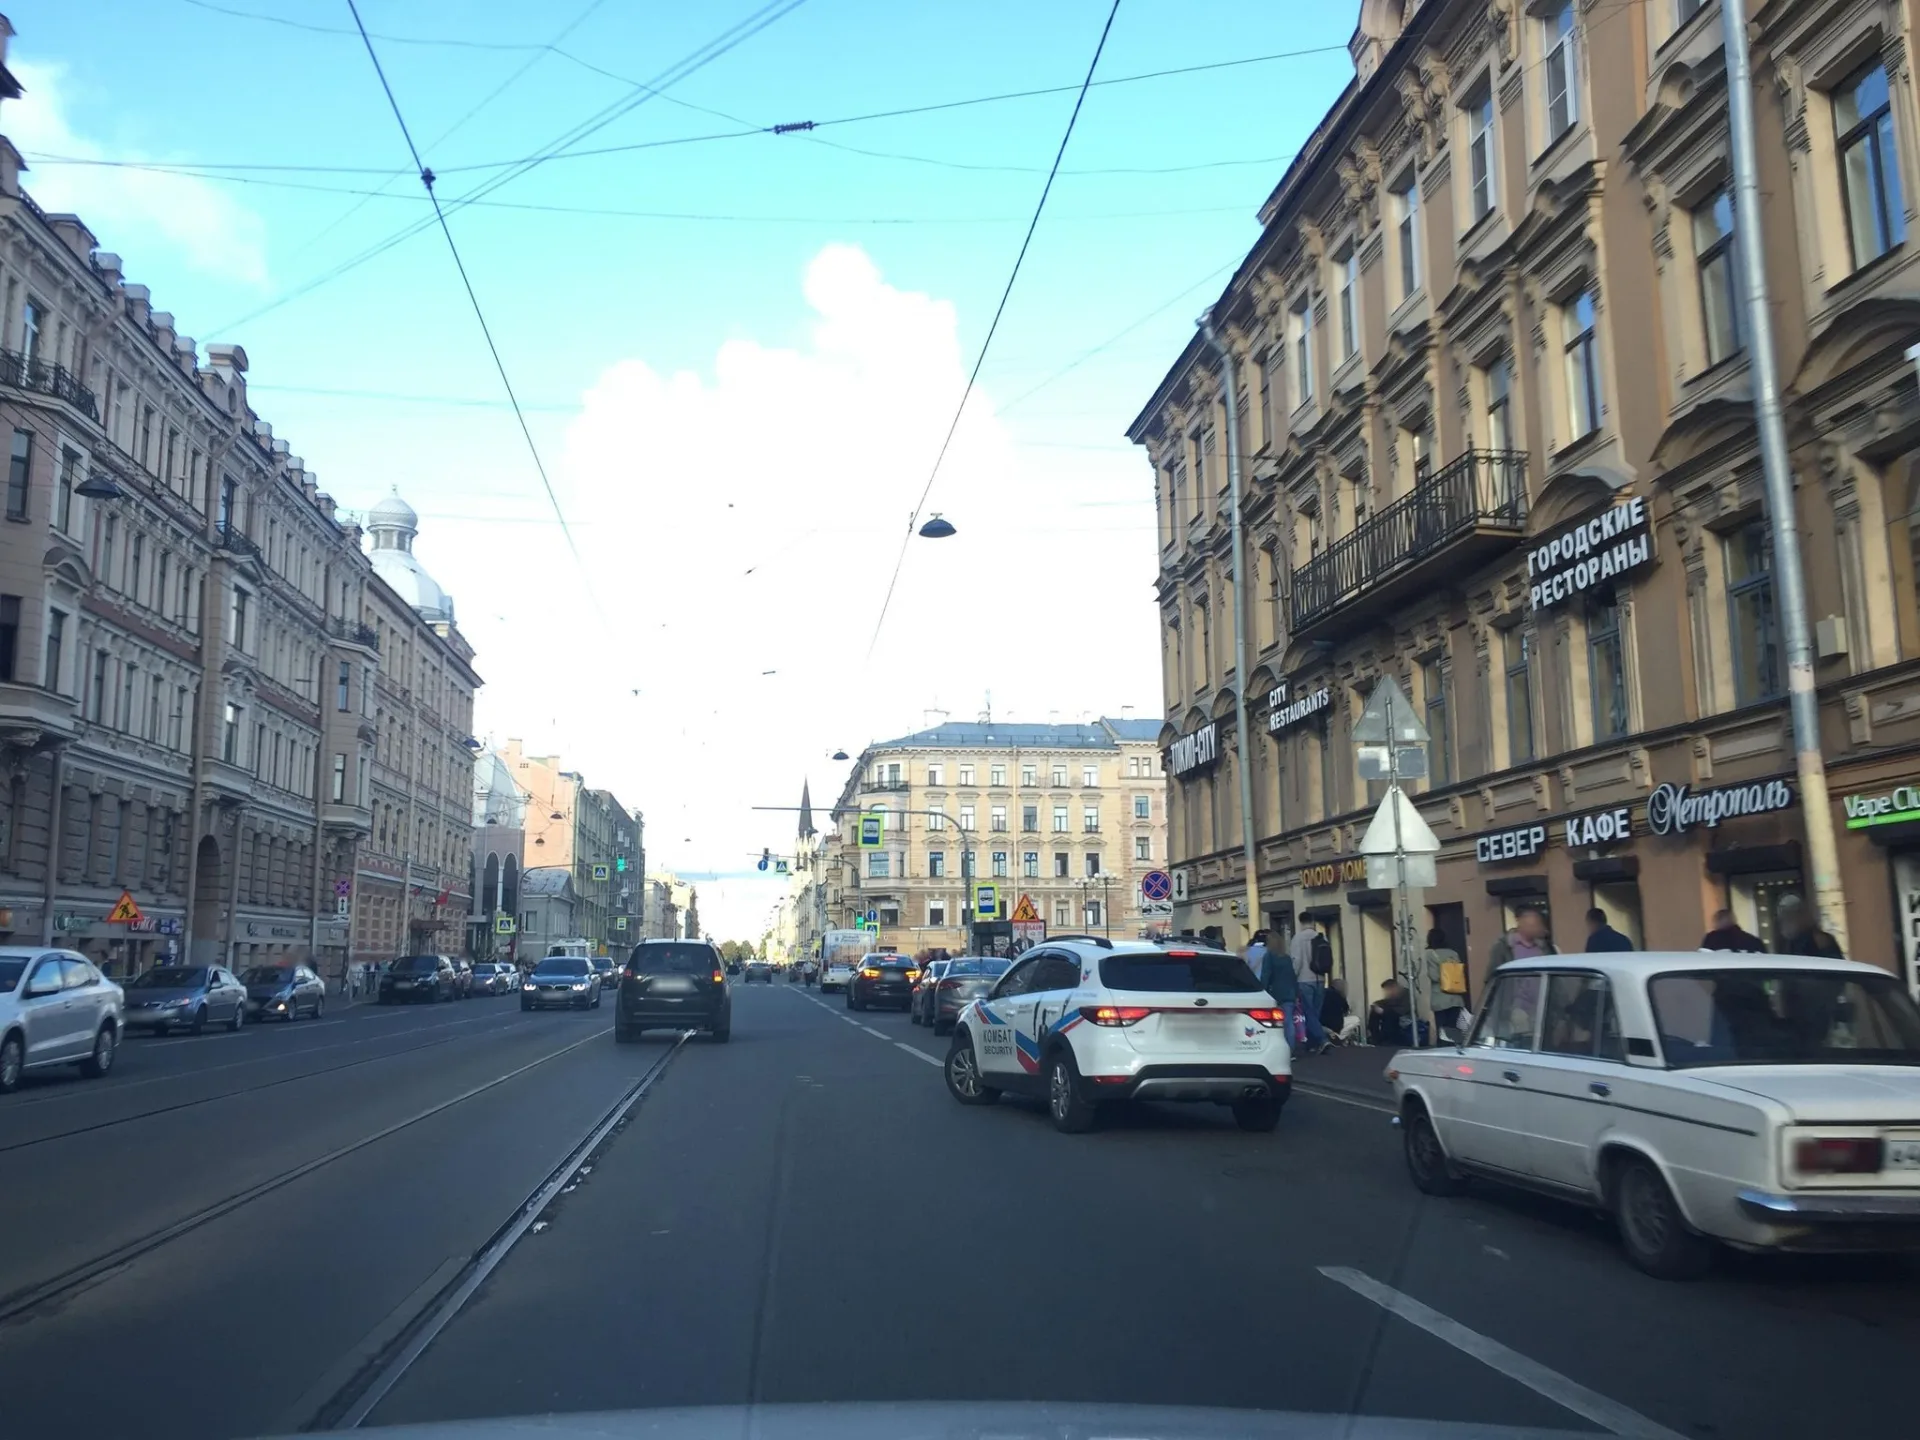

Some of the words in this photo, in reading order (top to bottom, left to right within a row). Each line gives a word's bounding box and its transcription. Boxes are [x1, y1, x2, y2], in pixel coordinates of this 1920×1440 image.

[1528, 496, 1644, 577] ГОРОДСКИЕ
[1531, 533, 1648, 611] РЕСТОРАНЫ
[1269, 684, 1286, 708] CITY
[1270, 687, 1329, 731] RESTAURANTS
[1566, 808, 1630, 847] КАФЕ
[1647, 783, 1790, 835] Метрополь
[1844, 795, 1891, 825] Vape
[1477, 826, 1545, 862] СЕВЕР
[983, 1029, 1012, 1043] КОМБАТ
[984, 1046, 1013, 1055] SECURITY
